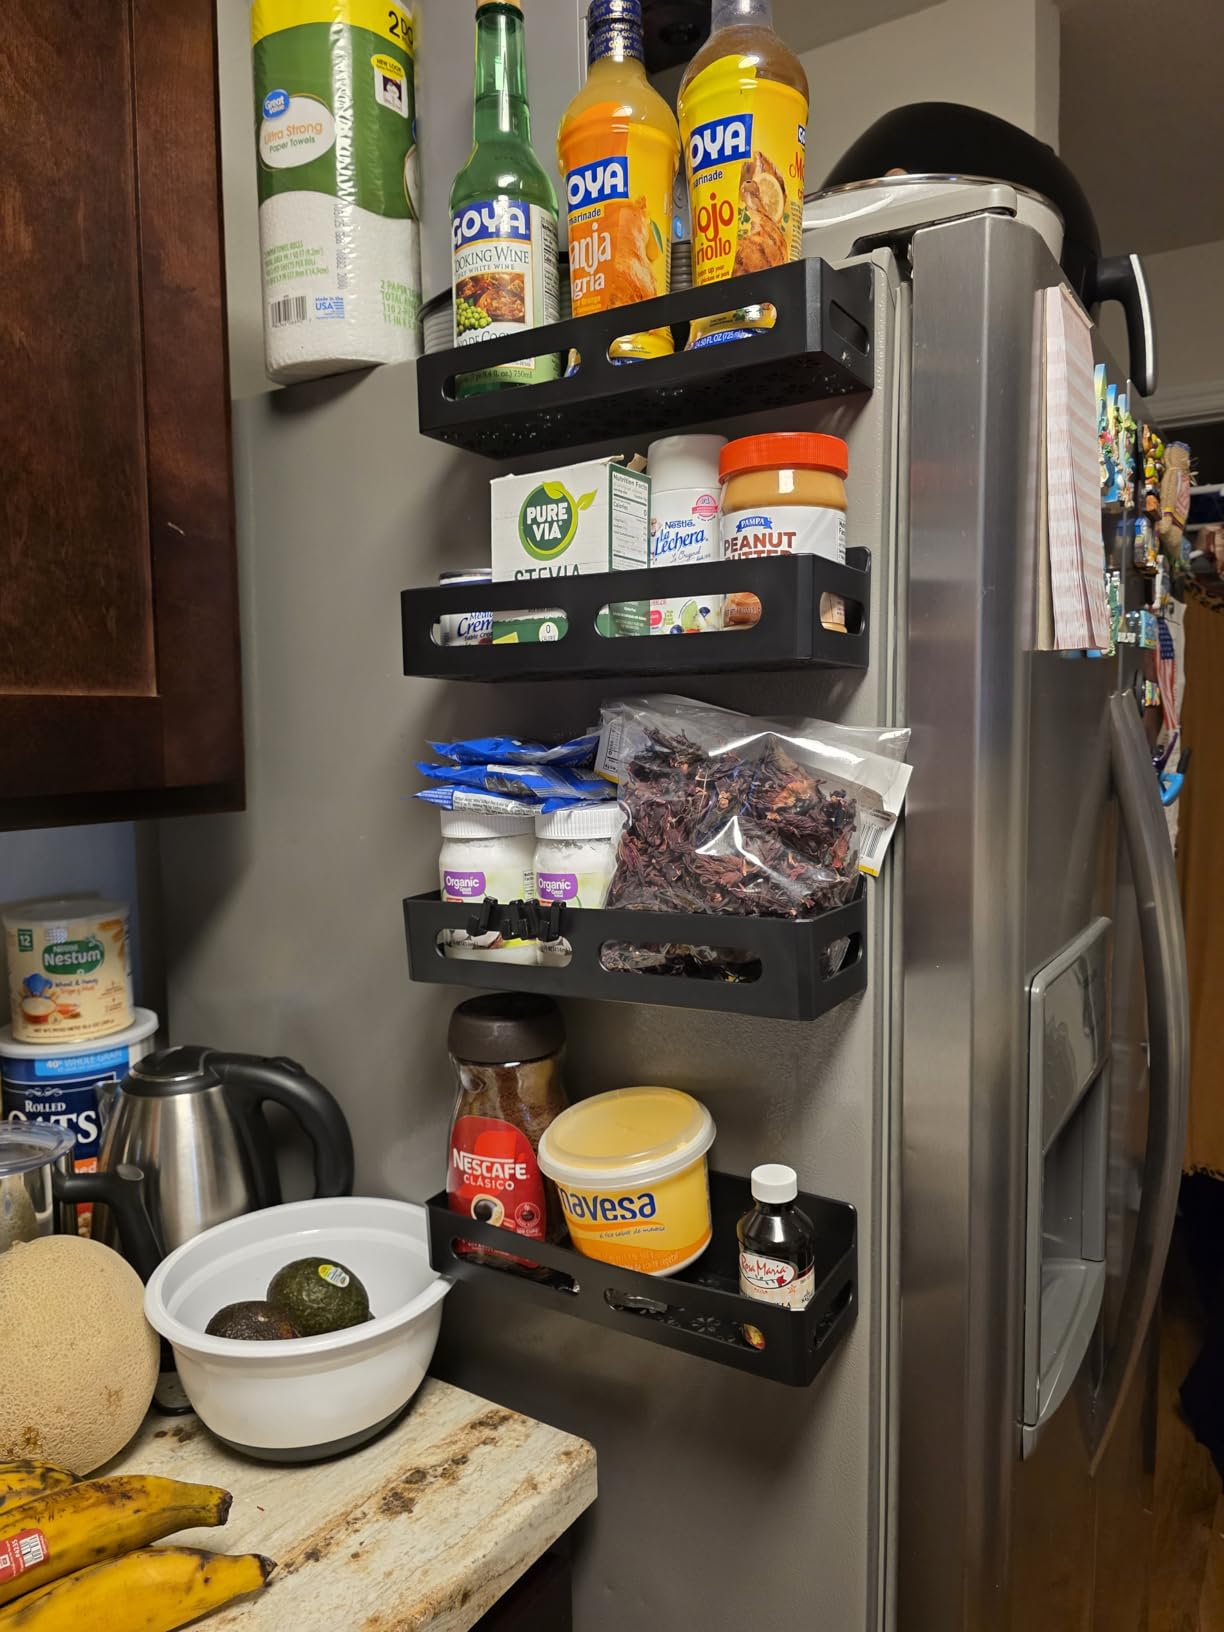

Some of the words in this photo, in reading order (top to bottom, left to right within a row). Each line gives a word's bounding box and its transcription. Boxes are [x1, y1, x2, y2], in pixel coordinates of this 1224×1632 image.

[388, 10, 400, 37] 2
[264, 95, 285, 111] Great
[263, 129, 284, 145] Ultra
[286, 122, 324, 138] Strong
[269, 138, 289, 154] Paper
[289, 135, 316, 148] Towels
[693, 170, 723, 188] arinade
[451, 203, 526, 248] GOYA
[694, 192, 735, 242] ojo
[494, 245, 530, 265] WINE
[315, 302, 334, 311] USA
[526, 502, 568, 525] PURE
[741, 517, 765, 528] PAMPA
[532, 521, 562, 541] VIA
[654, 528, 706, 557] Lechera
[723, 531, 797, 557] PEANUT
[445, 875, 480, 892] Organic
[538, 878, 572, 894] Organic
[19, 934, 31, 947] 12
[44, 949, 101, 967] Nestum
[25, 1100, 66, 1113] ROLLED
[7, 1110, 98, 1144] OTS
[741, 1254, 756, 1273] Rosa
